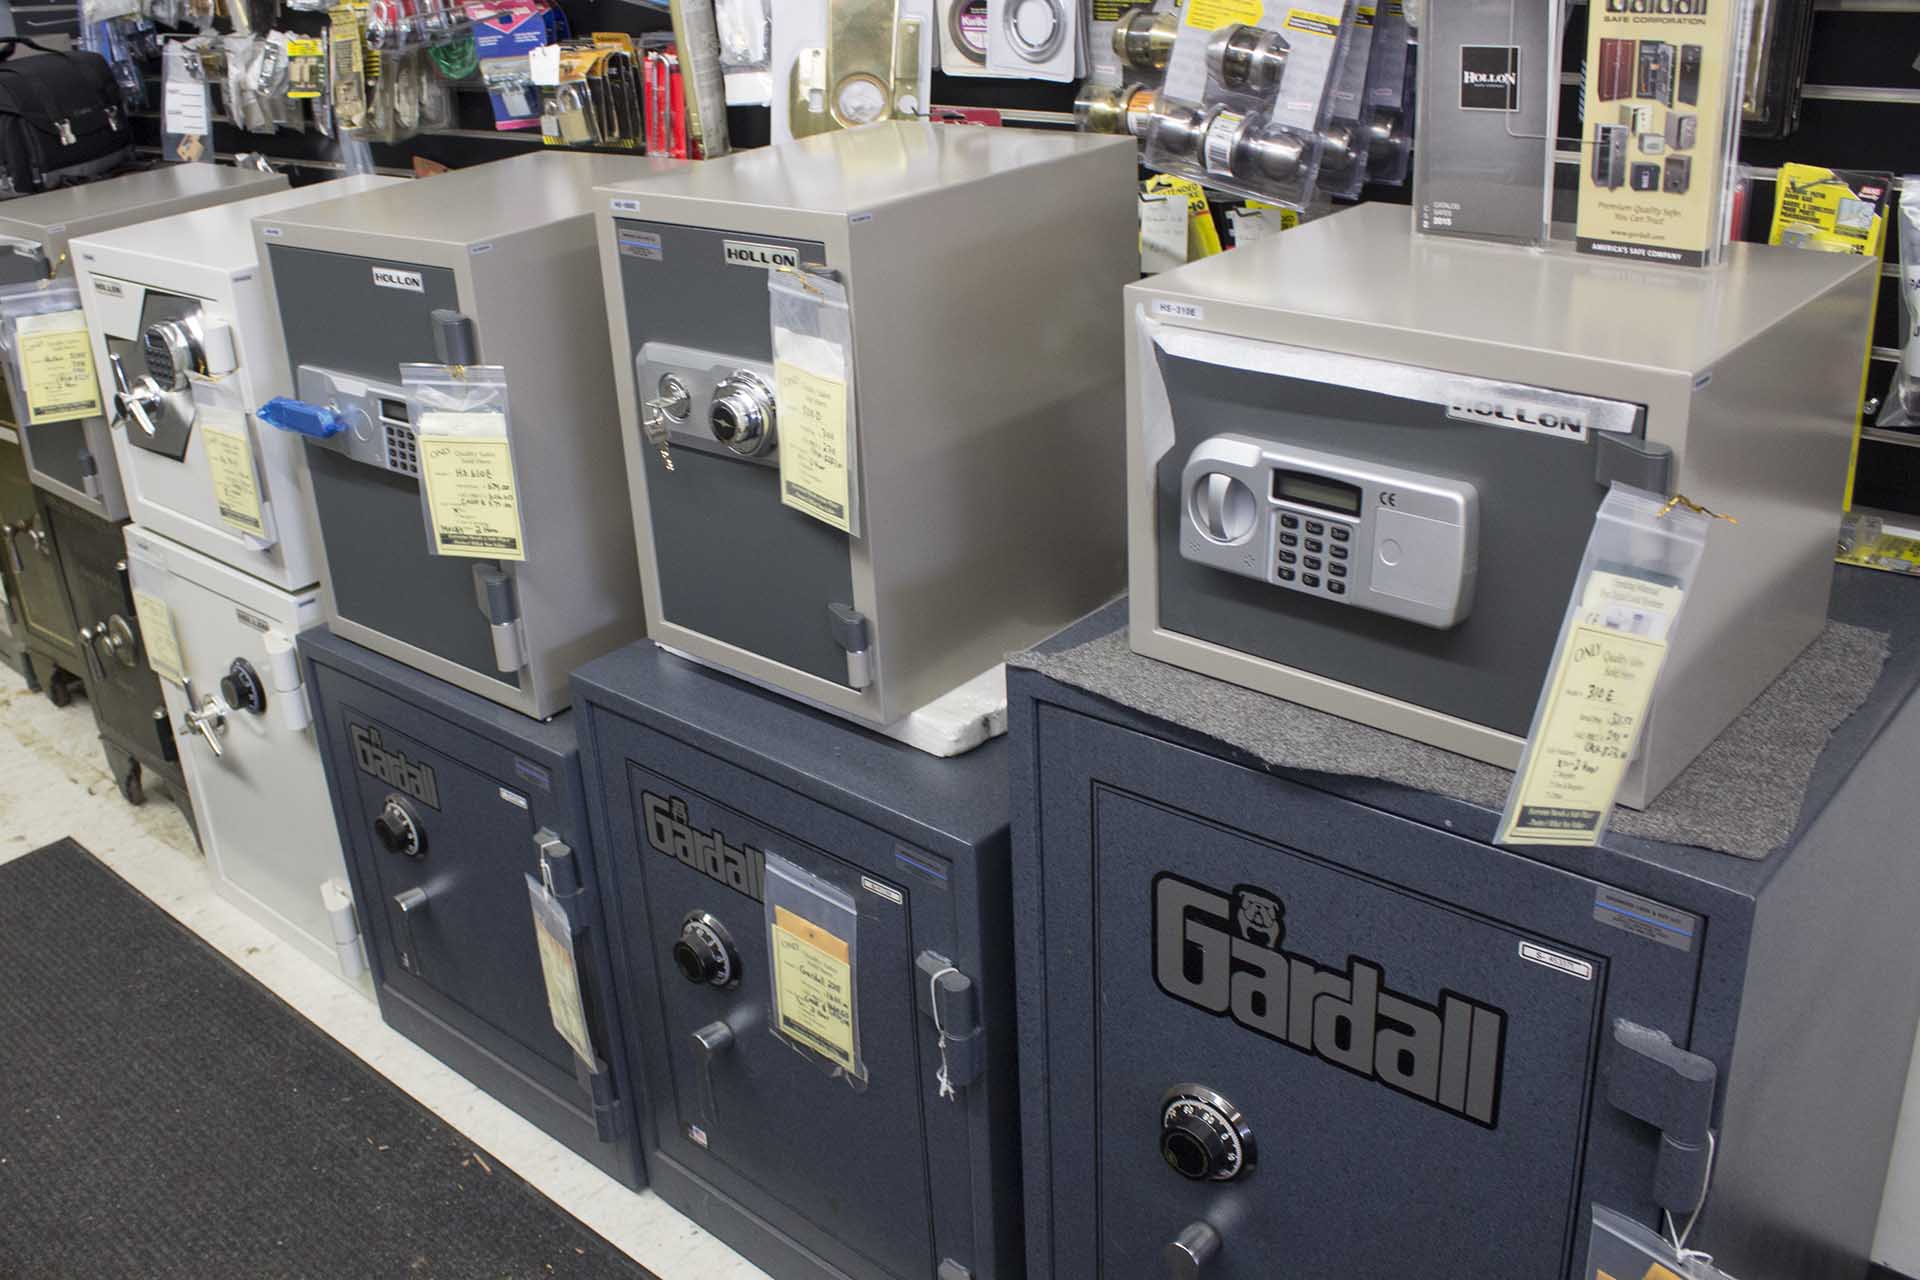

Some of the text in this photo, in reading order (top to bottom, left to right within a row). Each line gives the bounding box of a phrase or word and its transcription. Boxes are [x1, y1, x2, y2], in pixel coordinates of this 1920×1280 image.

[1603, 15, 1707, 25] SAFE CORPORATION
[1463, 70, 1517, 86] HOLLON
[1598, 201, 1632, 211] Premium
[1633, 203, 1661, 216] Quality
[1614, 212, 1628, 221] You
[1630, 214, 1644, 222] Can
[727, 247, 796, 267] HOLLON
[1592, 242, 1683, 260] AMERICA'S SAFE COMPANY
[375, 272, 421, 288] HOLLON
[1160, 303, 1196, 317] HS-310E
[1379, 491, 1397, 506] CE
[350, 722, 441, 812] Gardall
[642, 791, 765, 904] Gardall
[1152, 871, 1508, 1131] Gardall
